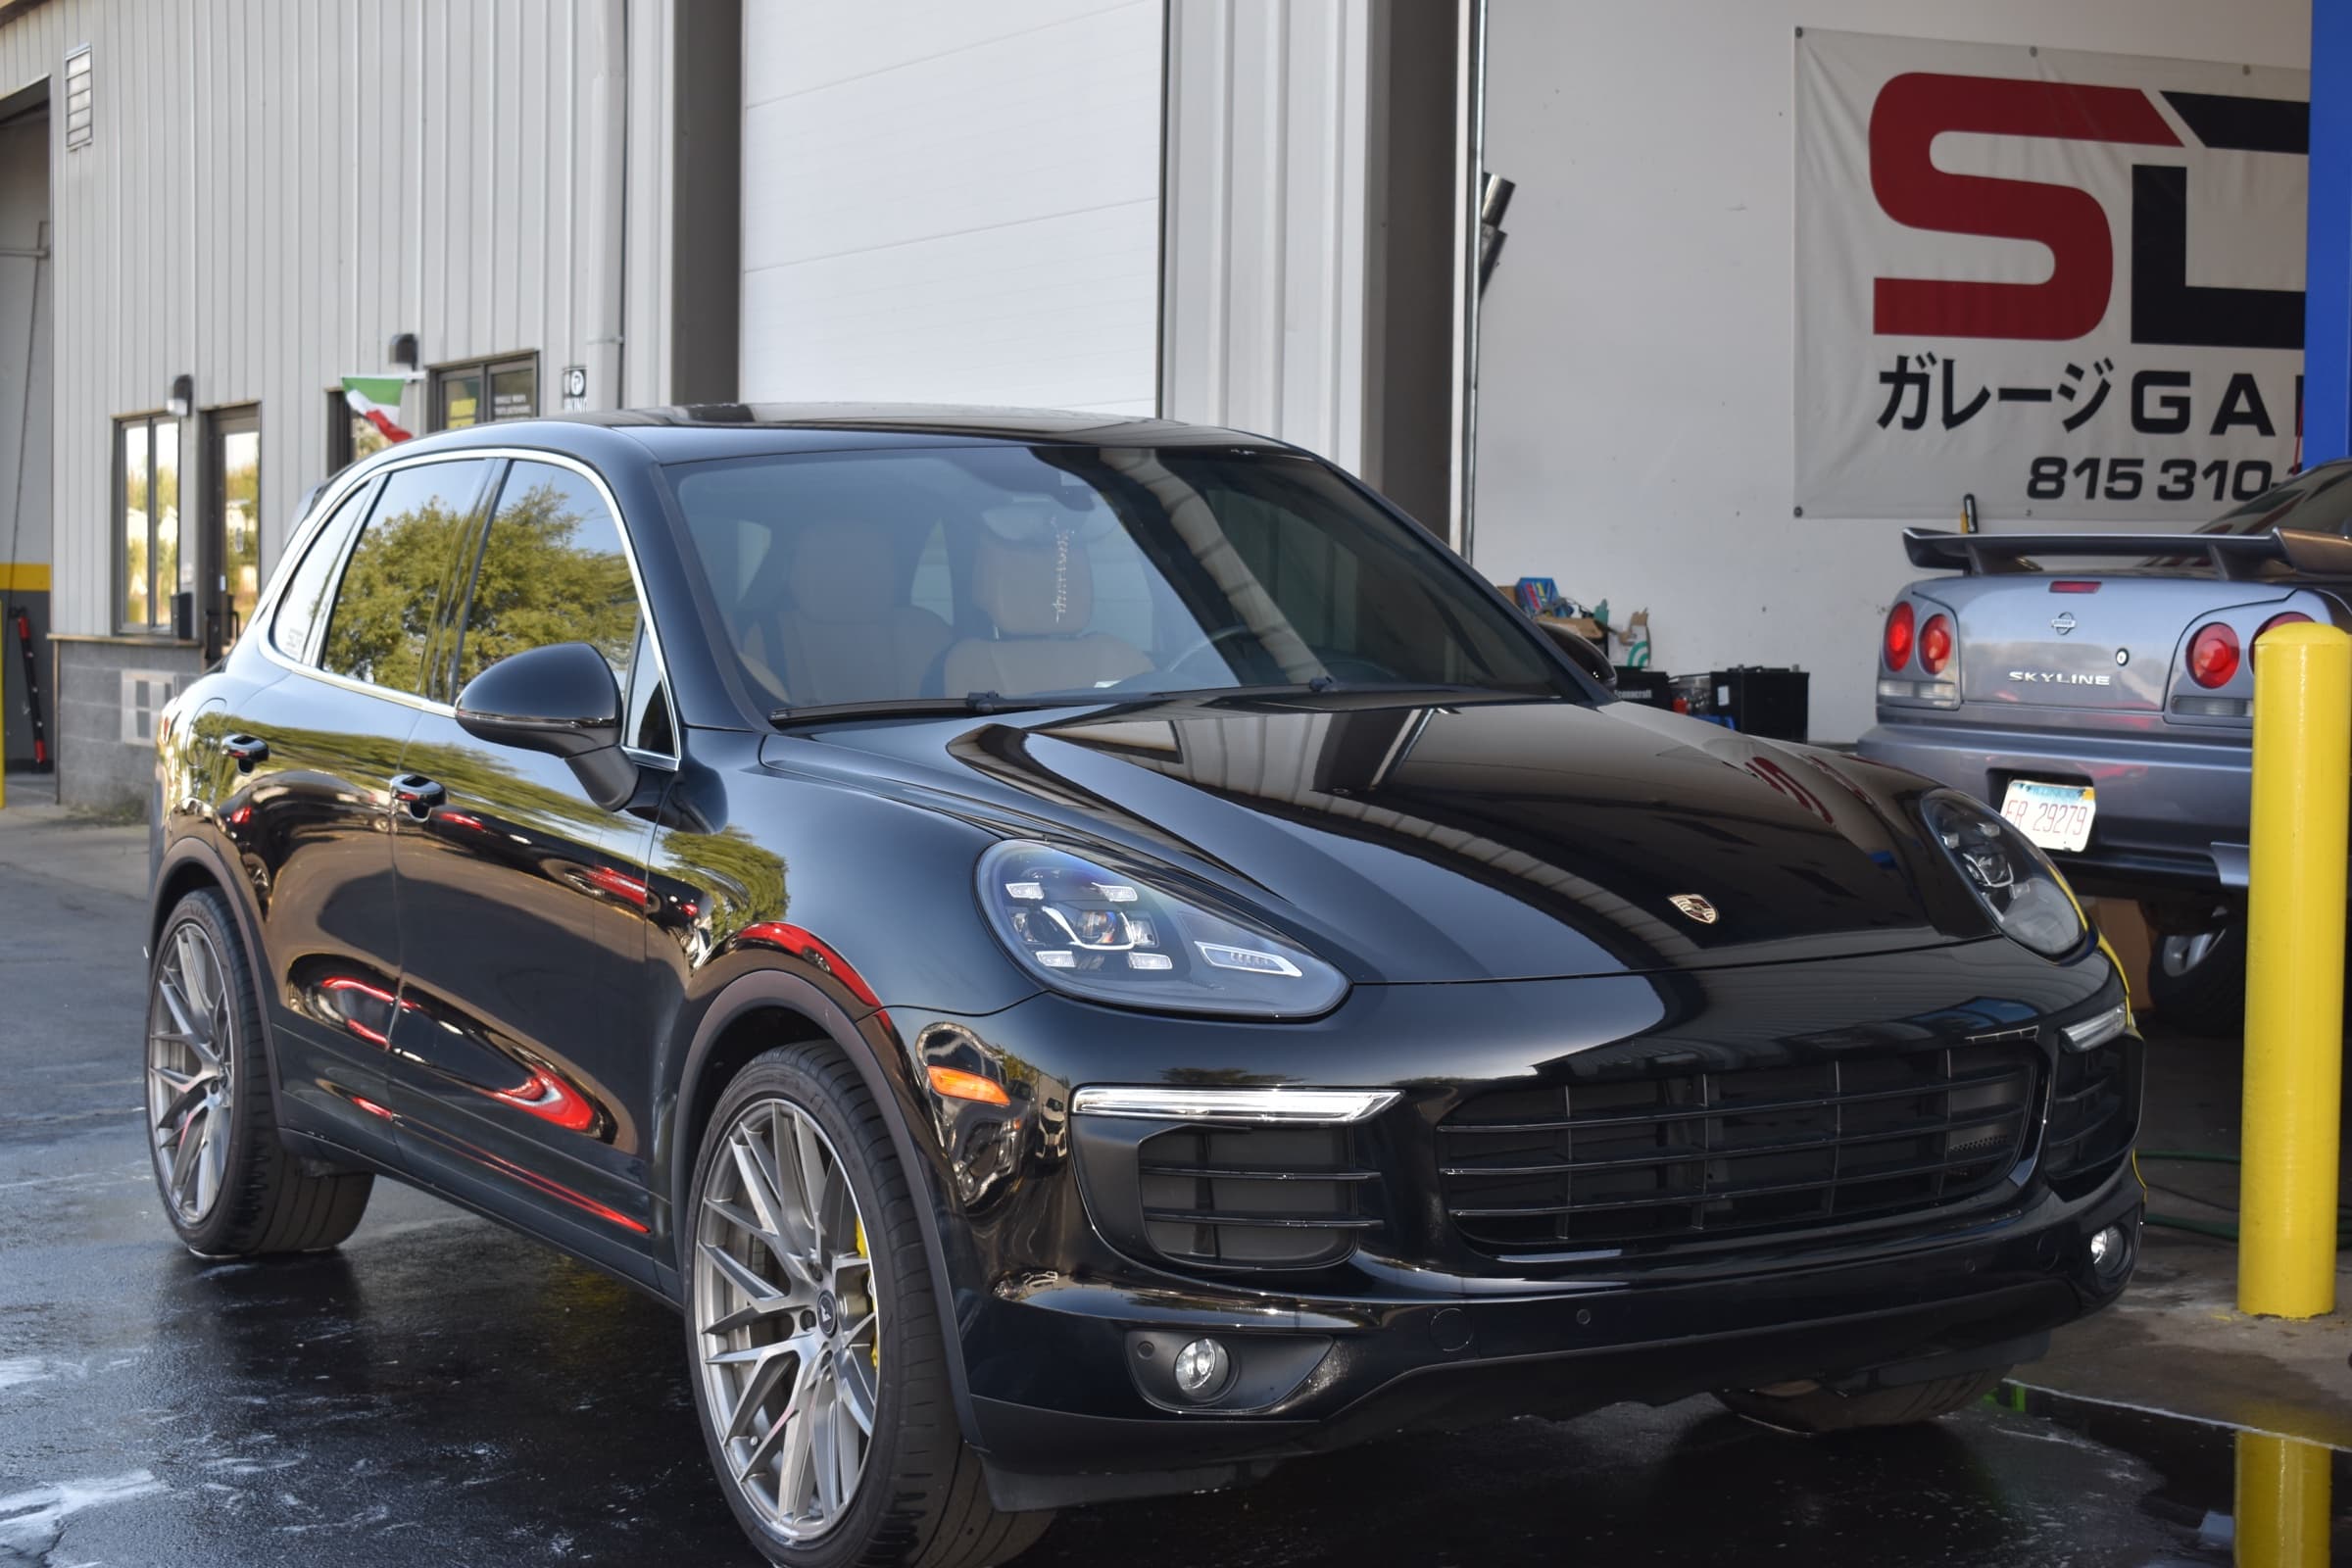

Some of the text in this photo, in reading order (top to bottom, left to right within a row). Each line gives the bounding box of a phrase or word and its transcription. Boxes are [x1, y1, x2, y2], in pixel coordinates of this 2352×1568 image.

[1877, 351, 2304, 437] ガレージ GA
[2027, 457, 2144, 501] 815
[2008, 671, 2110, 686] SKYLINE
[2033, 803, 2087, 835] 29279
